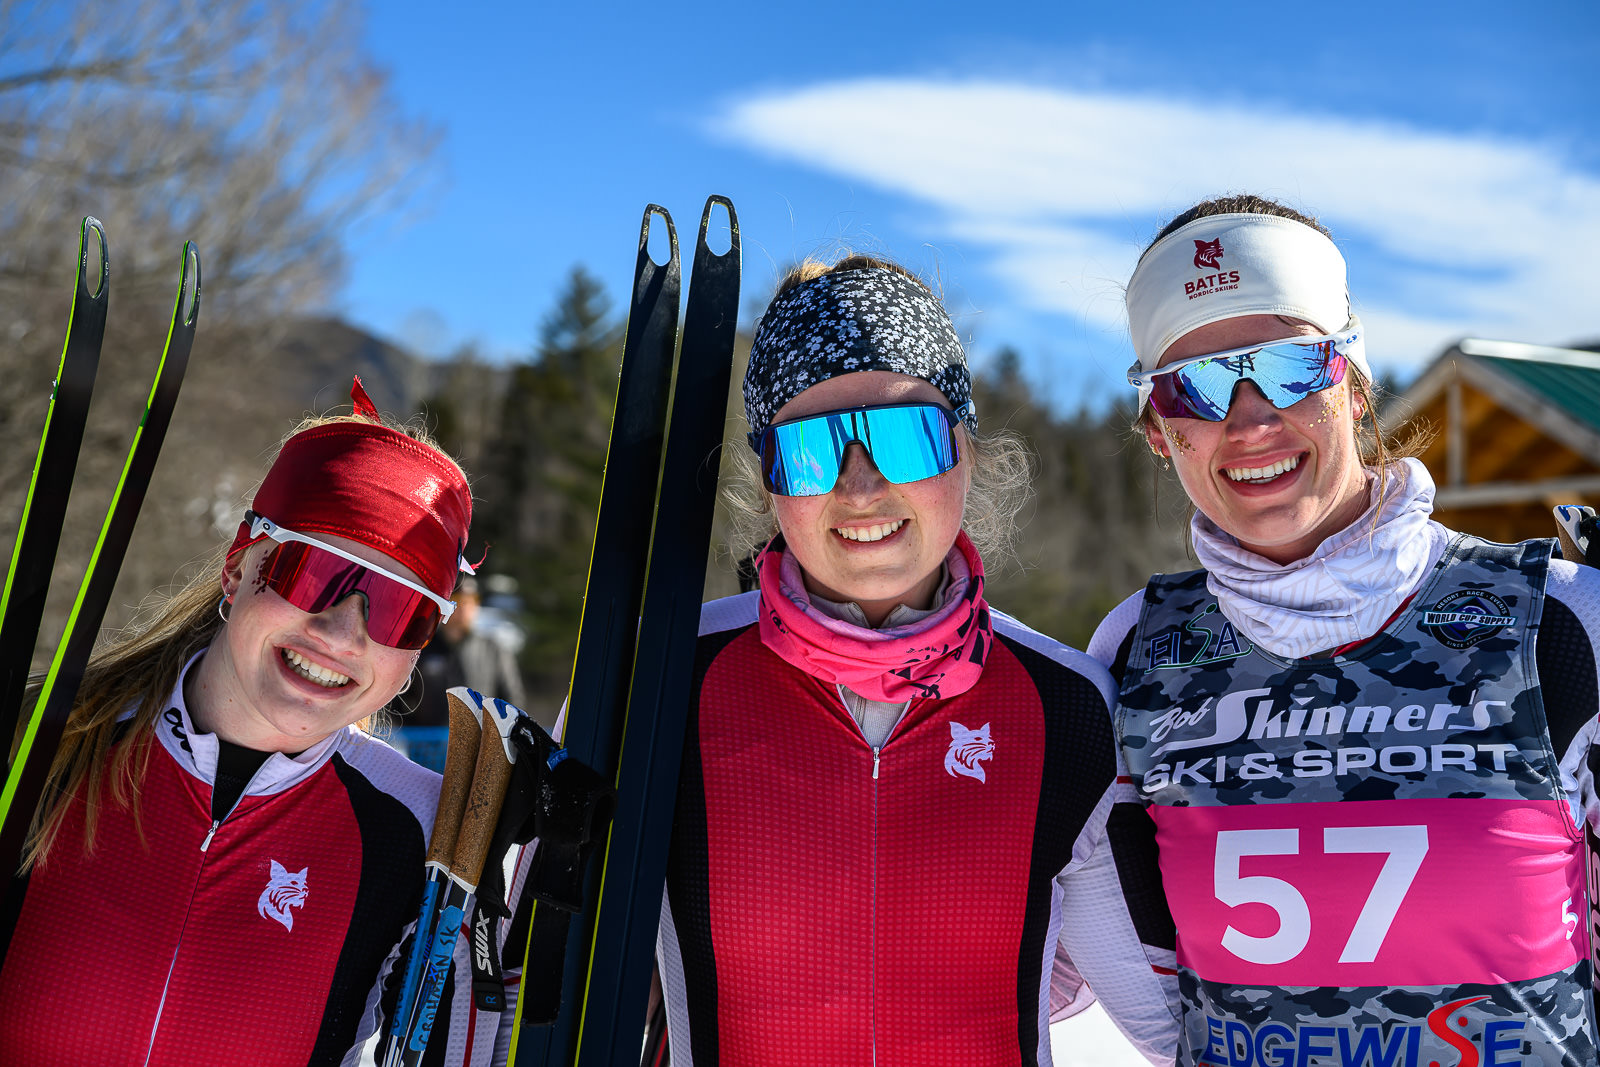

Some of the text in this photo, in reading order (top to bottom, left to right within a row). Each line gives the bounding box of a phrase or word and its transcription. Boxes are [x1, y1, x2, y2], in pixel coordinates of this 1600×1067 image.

[1184, 271, 1240, 295] BATES
[1189, 284, 1238, 300] NORDIC SKIING
[1427, 613, 1513, 625] WORLD CUP SUPPLY
[1436, 590, 1460, 609] RESORT
[1489, 595, 1508, 614] EVENTS
[1149, 687, 1507, 758] Bob Skinner's
[1142, 743, 1518, 793] SKI & SPORT
[1214, 825, 1430, 964] 57
[475, 908, 494, 977] SWIX
[485, 996, 497, 1004] R
[1201, 995, 1526, 1067] EDGEWISE
